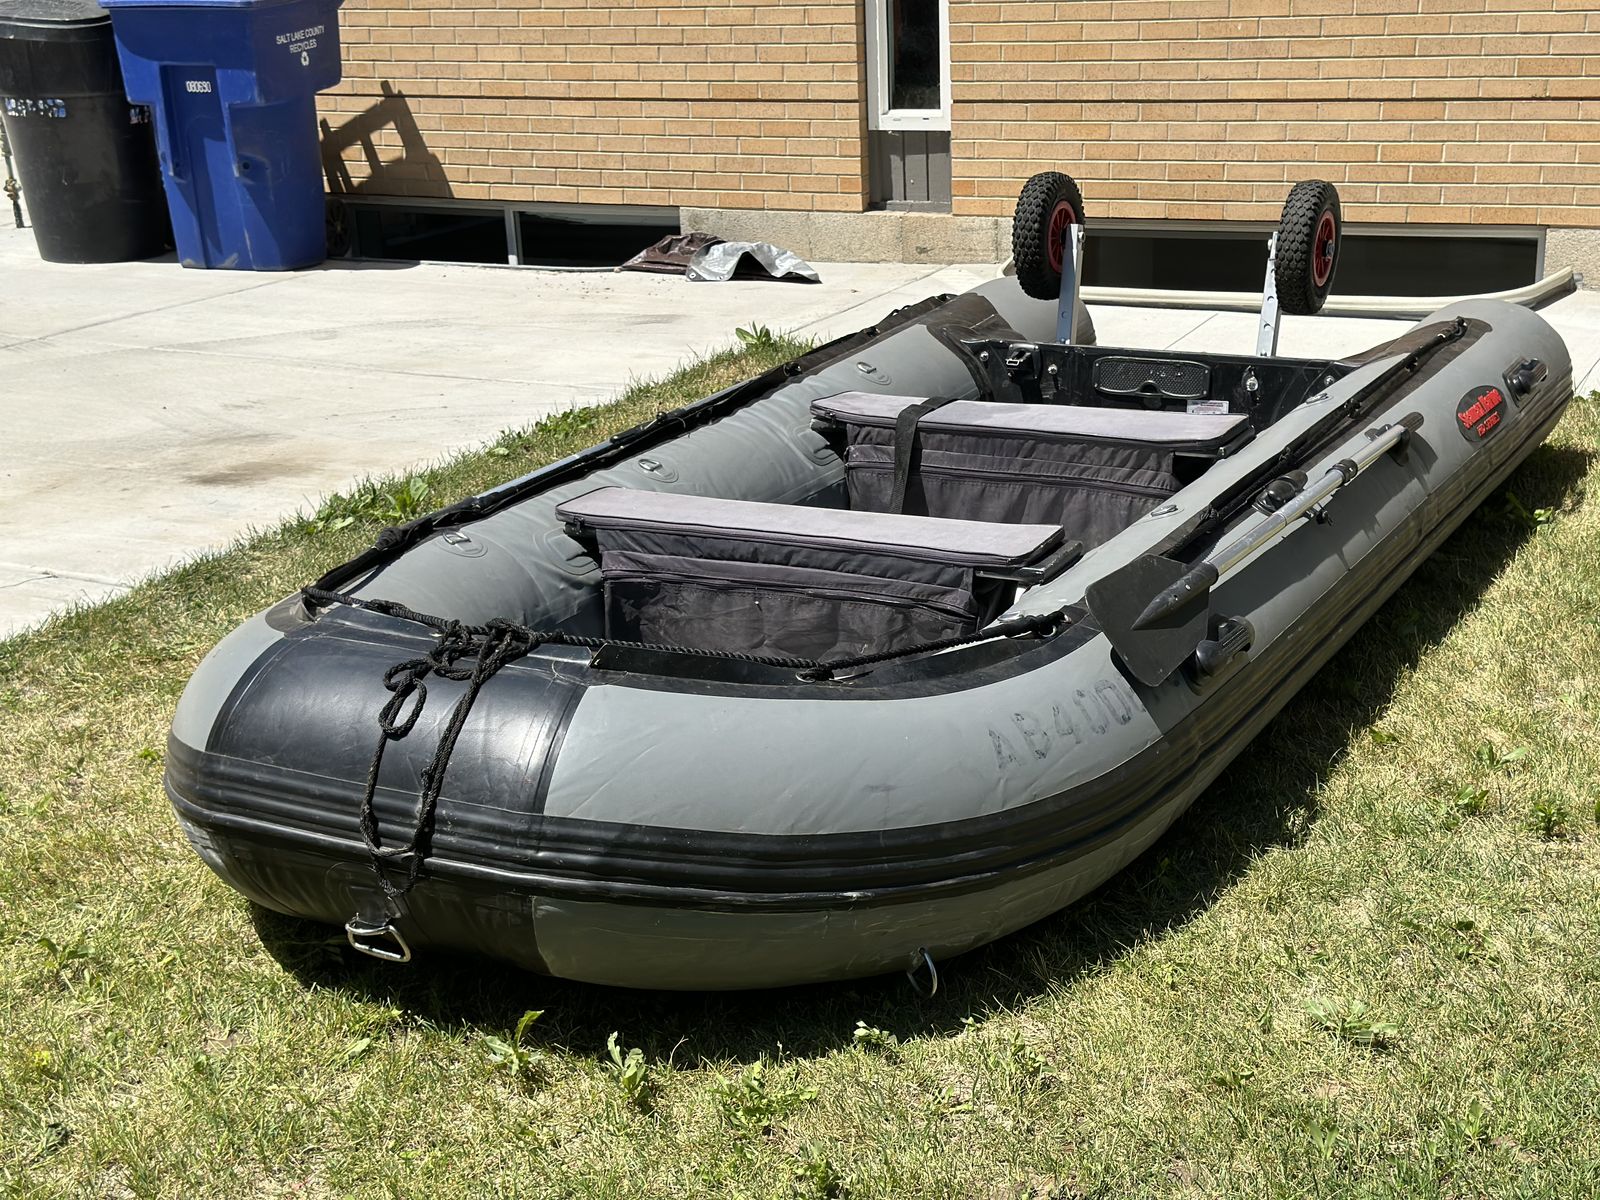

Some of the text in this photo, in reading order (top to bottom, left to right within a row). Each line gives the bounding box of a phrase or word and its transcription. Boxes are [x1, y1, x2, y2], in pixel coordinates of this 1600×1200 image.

[276, 25, 325, 45] SALT LAKE COUNTY
[289, 39, 317, 53] RECYCLES
